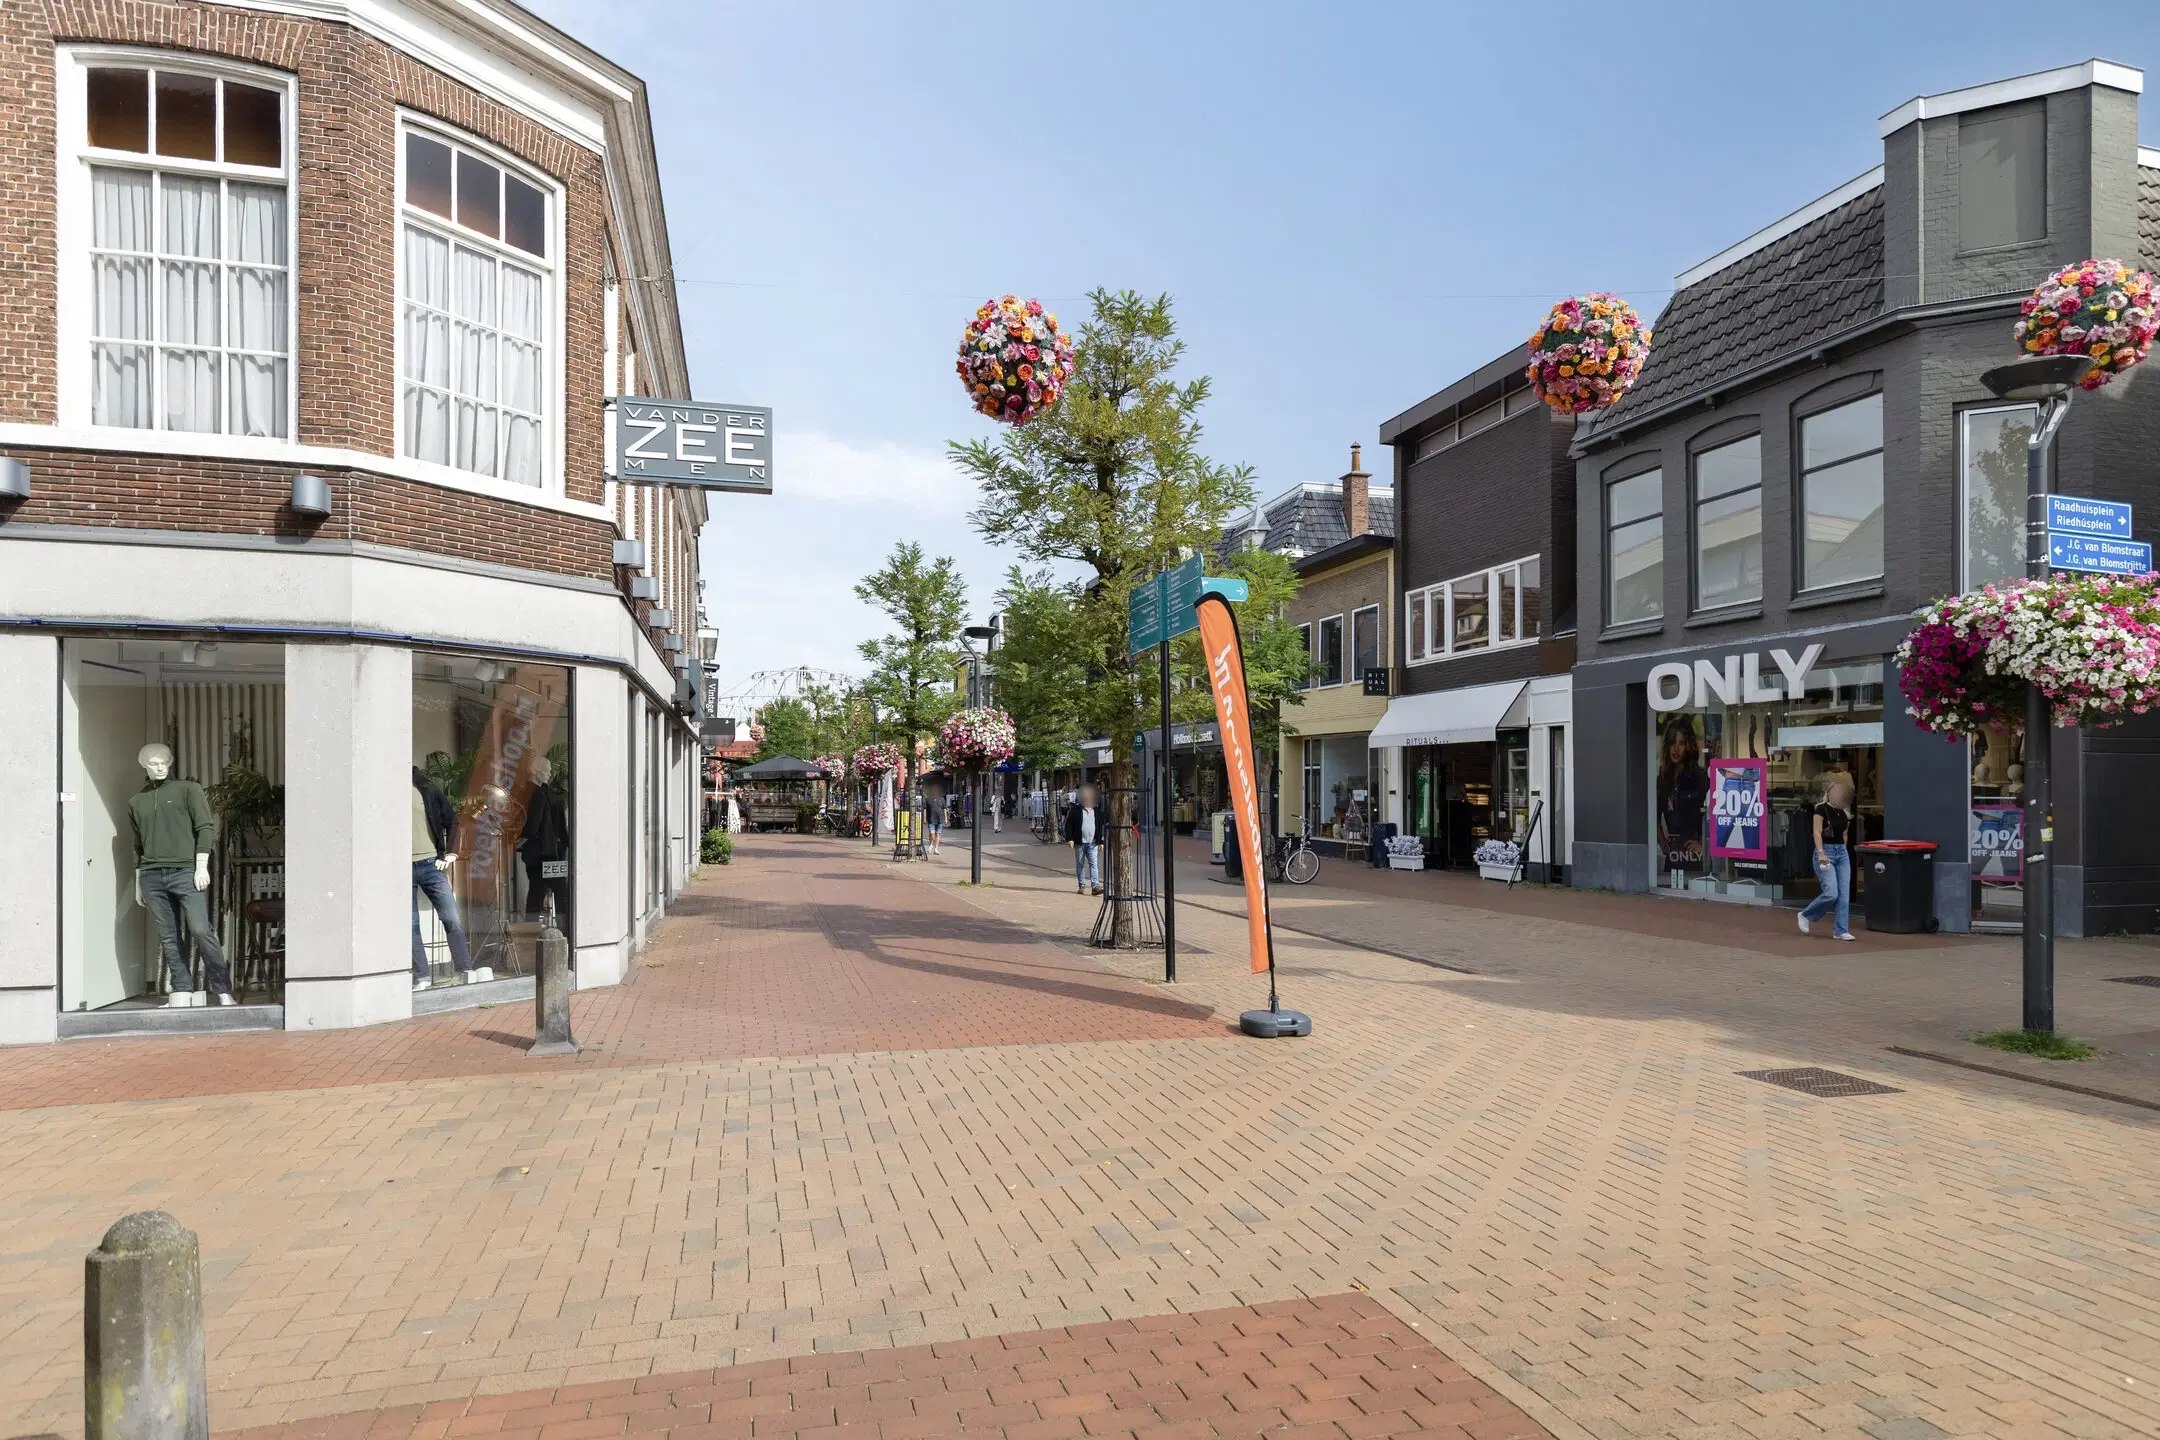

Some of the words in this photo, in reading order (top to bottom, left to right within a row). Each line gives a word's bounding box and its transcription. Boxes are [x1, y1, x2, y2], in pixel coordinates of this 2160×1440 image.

[625, 406, 689, 423] VAN
[702, 413, 765, 428] DER
[625, 419, 765, 466] ZEE
[625, 458, 765, 479] MEN
[2054, 500, 2114, 517] Raadhuisplein
[2056, 515, 2112, 531] Riedhúsplein
[2067, 539, 2082, 550] J.G.
[2084, 542, 2099, 552] van
[2101, 543, 2145, 557] Blomstraat
[2065, 554, 2081, 565] J.G.
[2083, 557, 2098, 567] van
[1647, 643, 1825, 711] ONLY
[705, 683, 716, 713] Vintage
[1712, 788, 1764, 817] 20%
[1717, 816, 1732, 826] OFF
[1733, 816, 1758, 827] JEANS
[1971, 828, 2024, 850] 20%
[1669, 850, 1703, 862] ONLY
[1972, 849, 1988, 857] OFF
[1989, 849, 2017, 857] JEANS
[544, 865, 568, 874] ZEE
